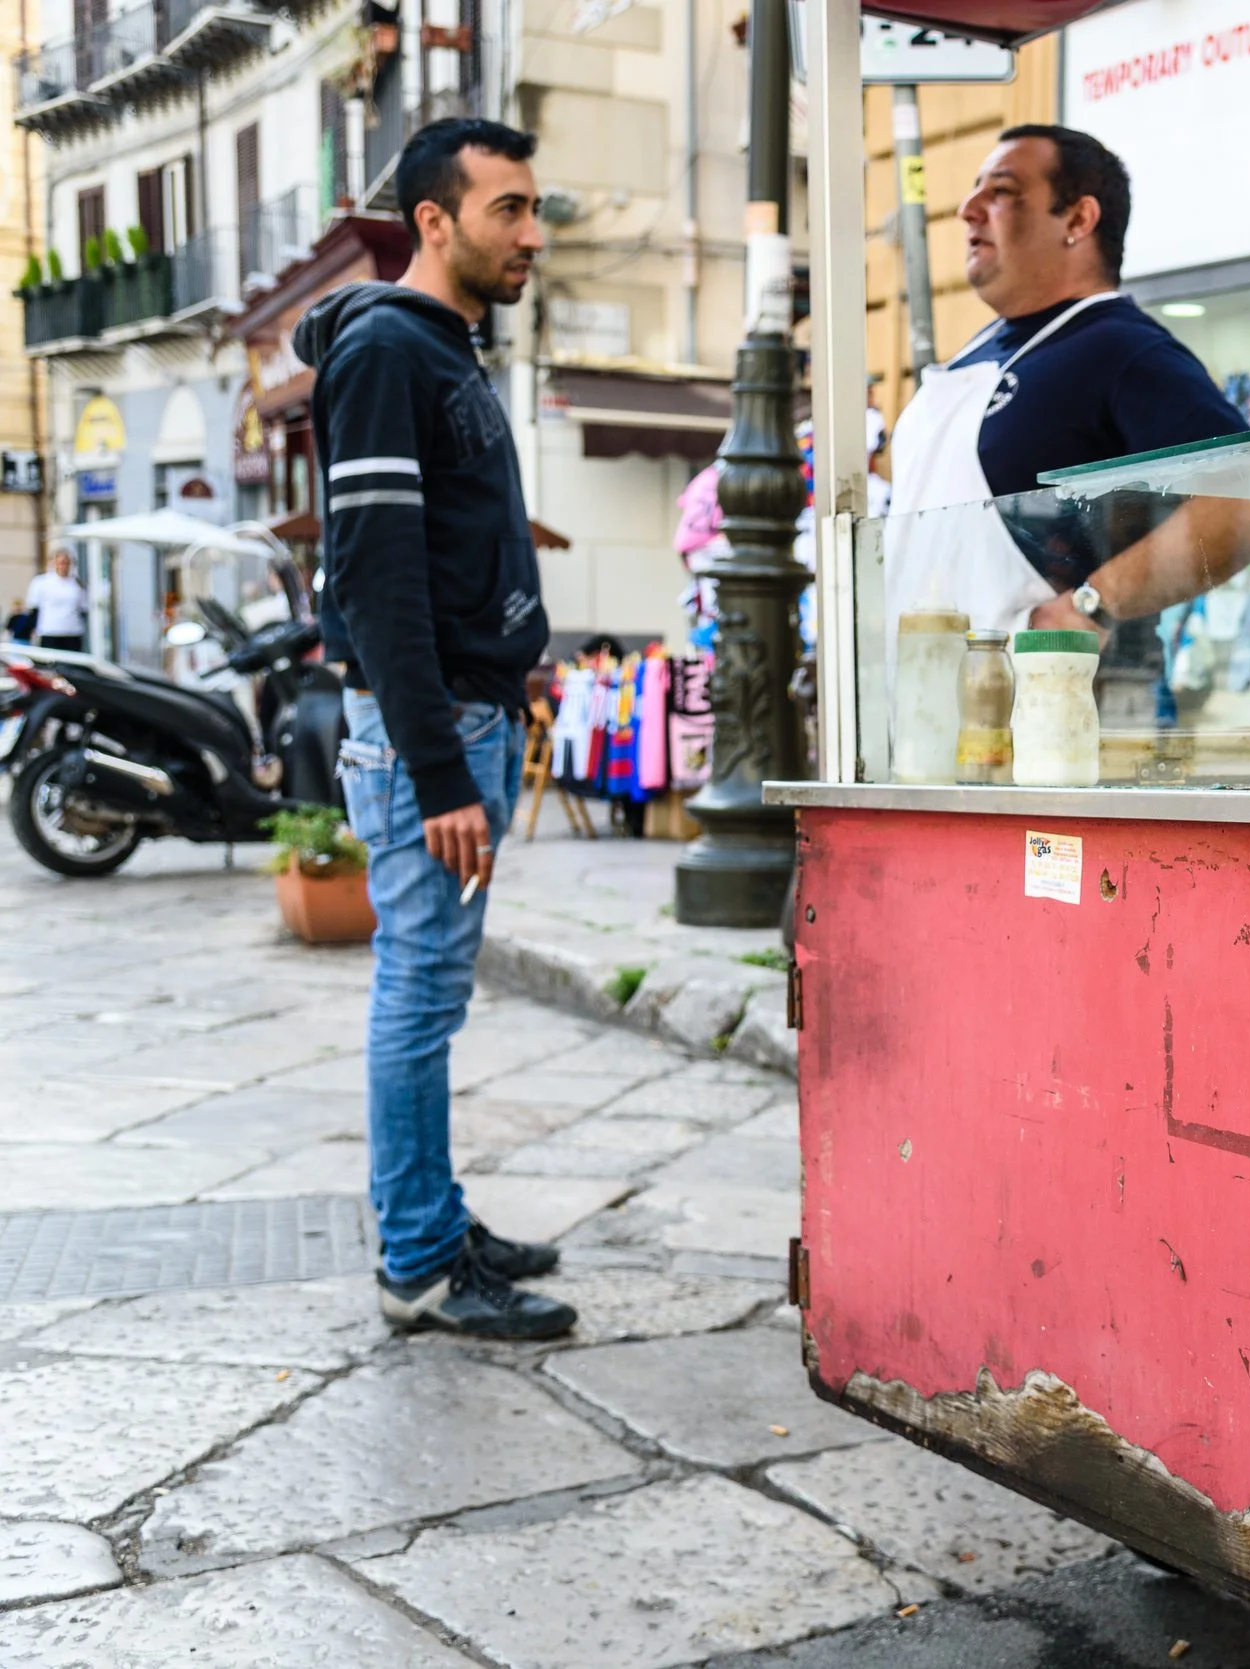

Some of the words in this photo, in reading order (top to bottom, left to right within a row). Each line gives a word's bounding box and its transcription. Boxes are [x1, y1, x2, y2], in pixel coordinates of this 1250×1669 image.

[1084, 42, 1193, 102] TEMPORARY
[1029, 836, 1045, 849] Jolly
[1037, 845, 1052, 858] gas
